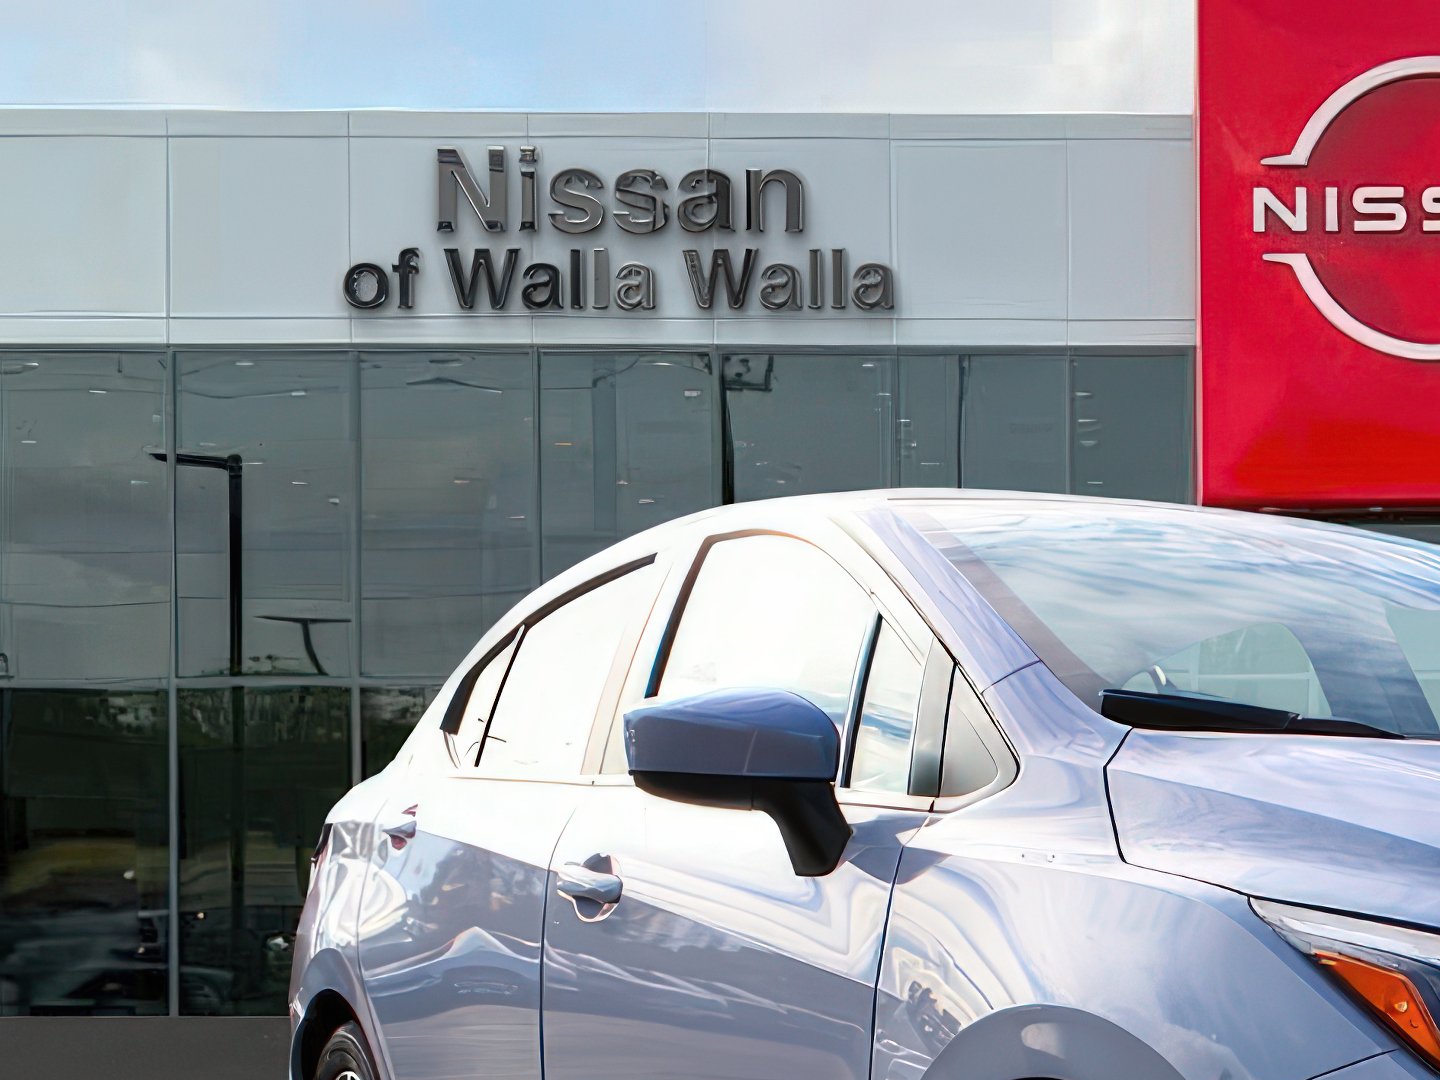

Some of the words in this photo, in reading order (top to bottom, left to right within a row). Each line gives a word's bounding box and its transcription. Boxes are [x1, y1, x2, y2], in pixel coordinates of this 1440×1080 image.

[436, 145, 806, 235] Nissan
[343, 247, 420, 311] of
[443, 247, 658, 311] Walla
[682, 247, 896, 311] Walla
